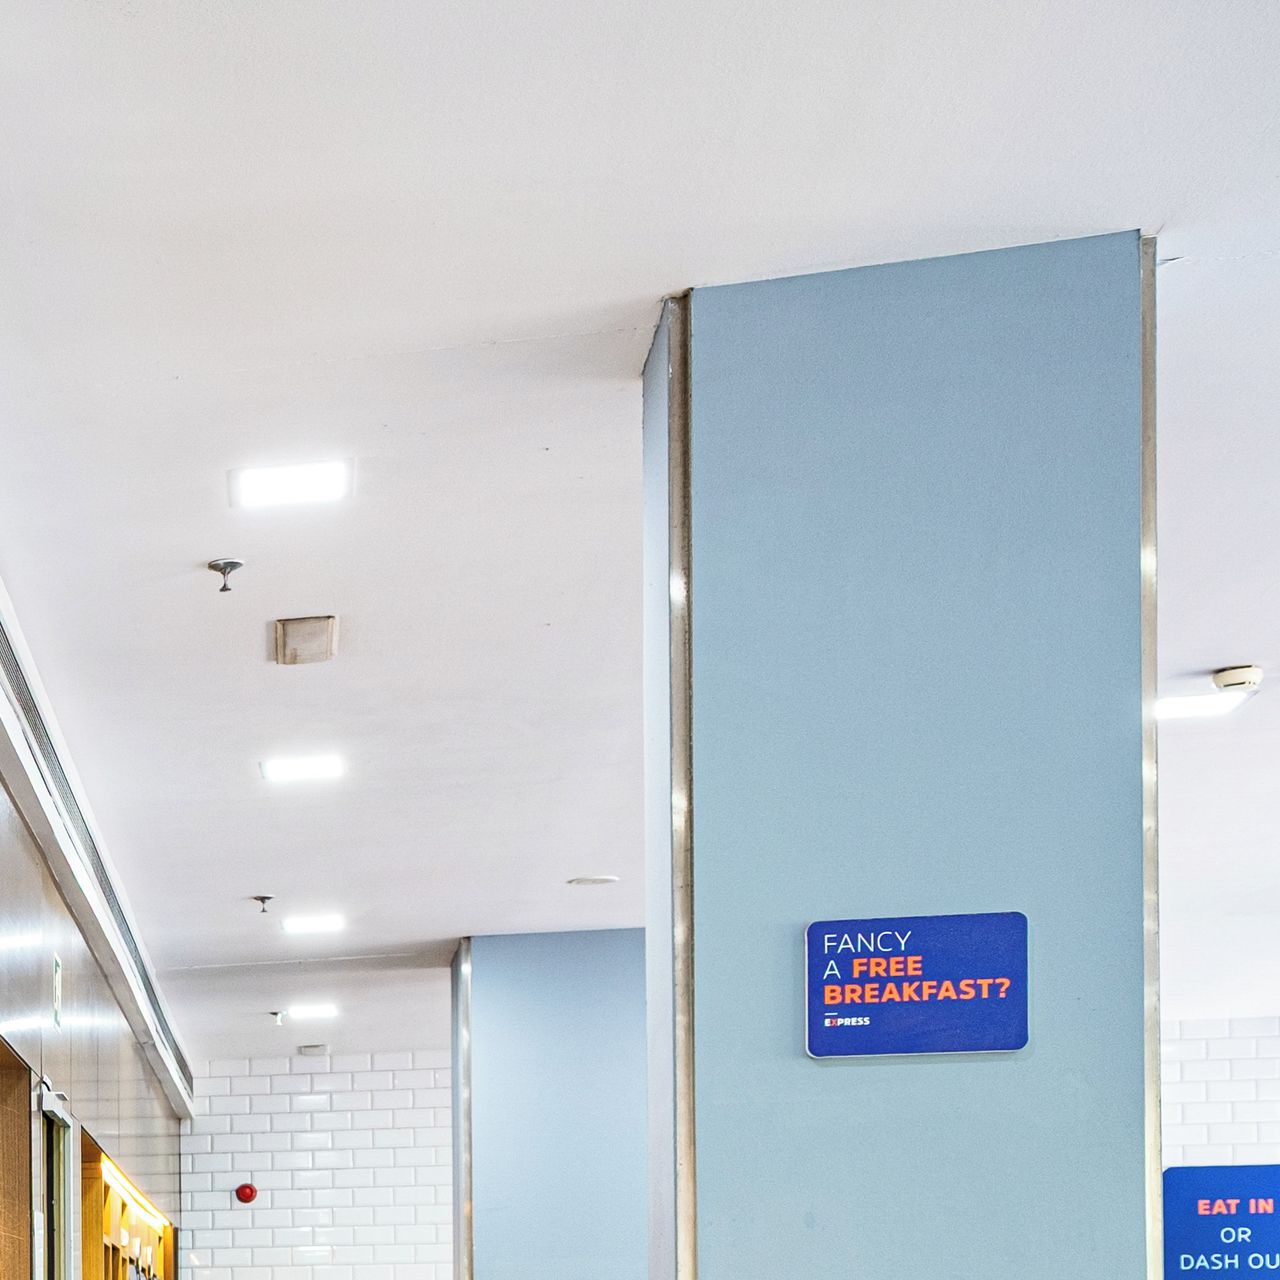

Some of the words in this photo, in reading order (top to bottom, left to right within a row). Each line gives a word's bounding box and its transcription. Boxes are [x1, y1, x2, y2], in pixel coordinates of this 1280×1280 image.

[824, 930, 912, 954] FANCY
[823, 959, 841, 980] A
[852, 955, 923, 979] FREE
[823, 977, 1011, 1005] BREAKFAST?
[824, 1016, 871, 1027] EXPRESS
[1197, 1199, 1240, 1216] EAT
[1249, 1198, 1274, 1214] IN
[1220, 1226, 1252, 1243] OR
[1180, 1253, 1239, 1270] DASH
